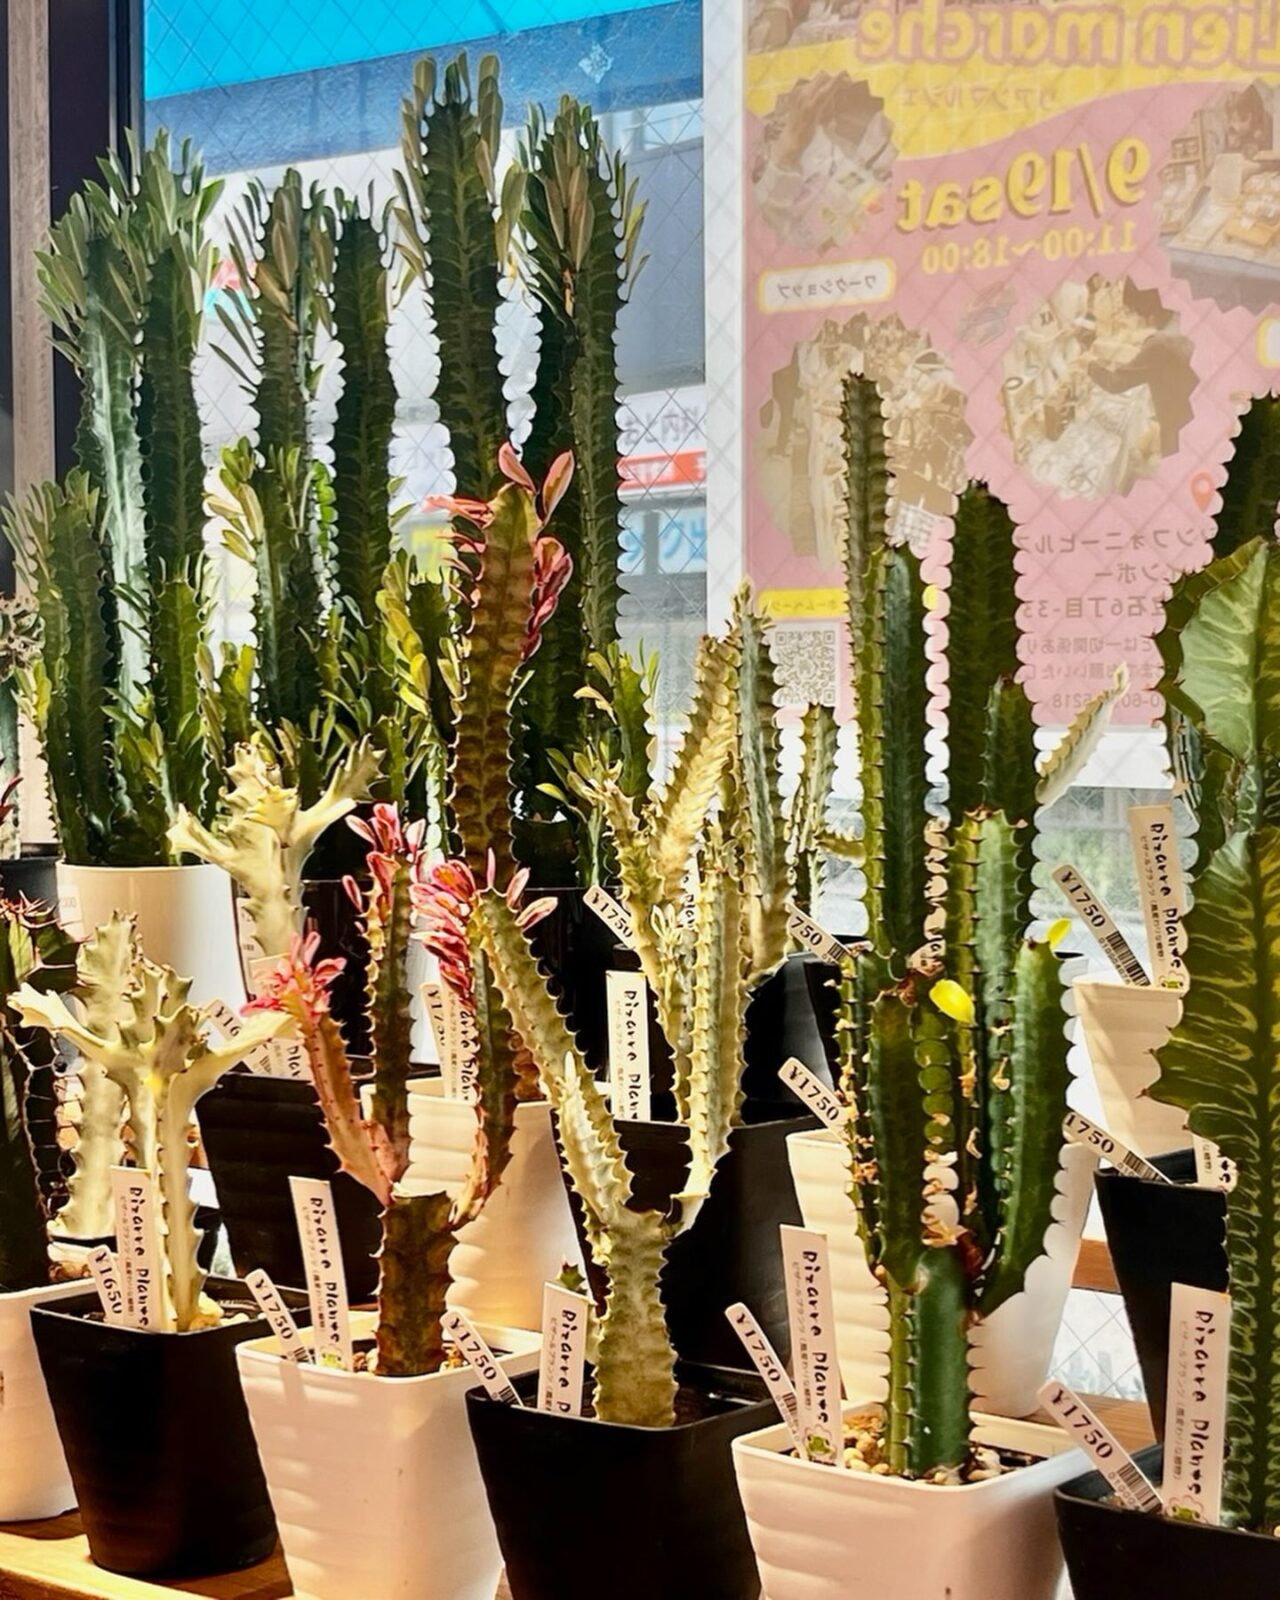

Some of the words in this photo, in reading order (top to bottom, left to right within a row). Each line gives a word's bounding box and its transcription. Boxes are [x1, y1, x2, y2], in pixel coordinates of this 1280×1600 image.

[1060, 870, 1107, 928] ¥1750
[790, 916, 824, 947] 750
[787, 1065, 840, 1121] ¥1750
[1065, 1113, 1116, 1155] 1750
[254, 1277, 295, 1341] ¥1750
[449, 1317, 498, 1381] ¥1750
[735, 1313, 781, 1383] ¥1750
[1050, 1388, 1114, 1460] ¥1750
